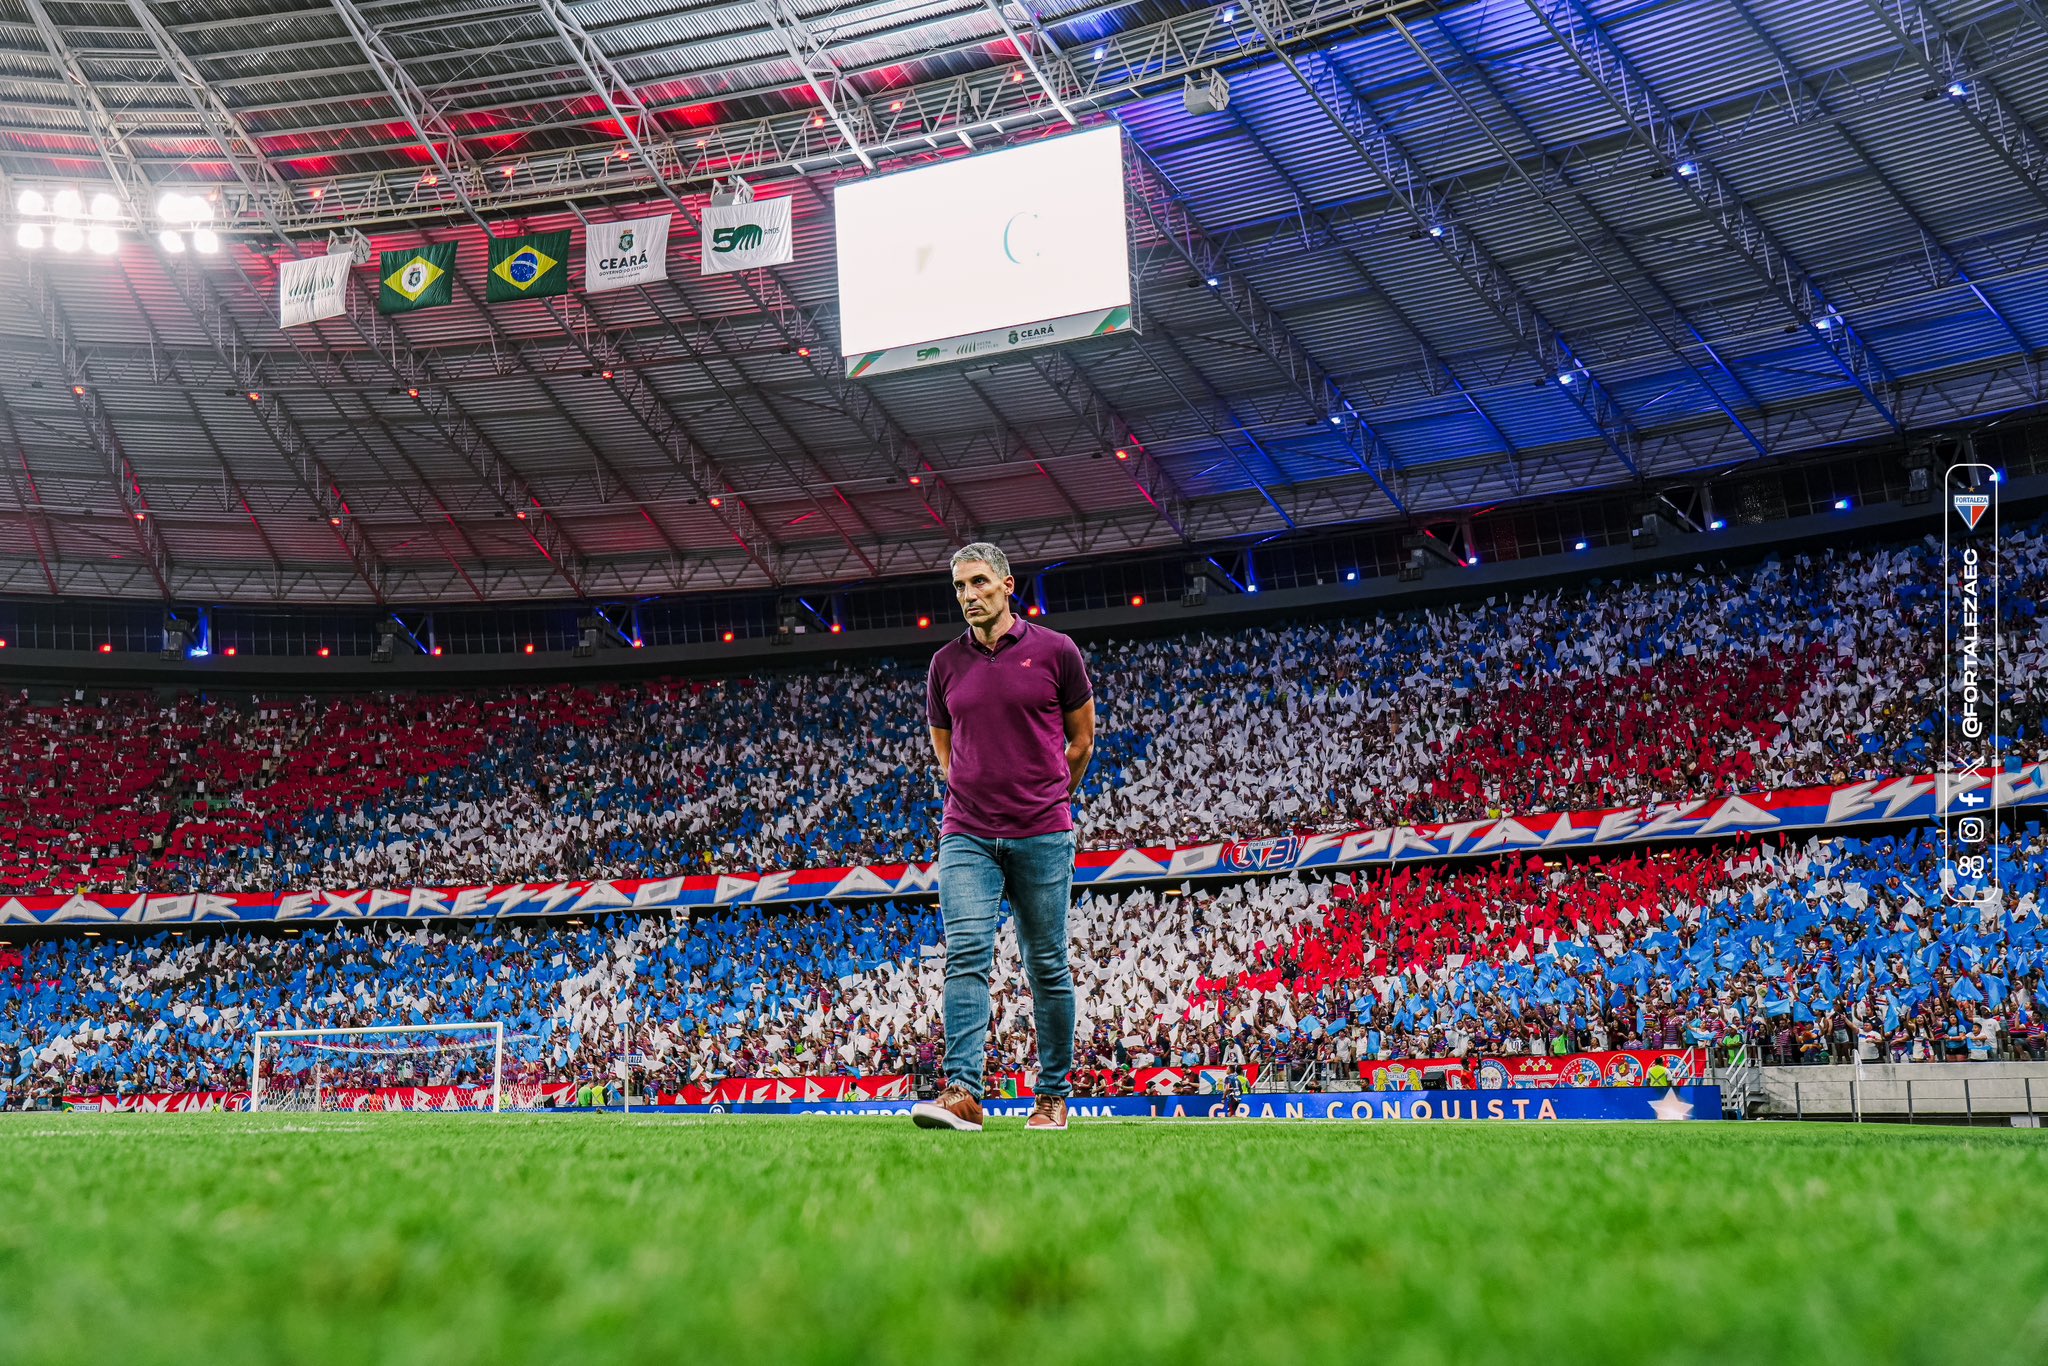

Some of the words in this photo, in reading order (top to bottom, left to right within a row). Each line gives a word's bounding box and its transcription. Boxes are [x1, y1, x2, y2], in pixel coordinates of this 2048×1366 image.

[599, 250, 648, 270] CEARÁ
[599, 269, 623, 277] GOVERNO
[631, 264, 649, 272] ESTADO
[1020, 324, 1055, 338] CEARÁ
[1249, 839, 1277, 849] FORTALEZA
[274, 876, 684, 921] EXPRESSÃO
[714, 870, 796, 903] DE
[1095, 843, 1224, 882] AO
[1296, 794, 1781, 868] FORTALEZA
[1151, 1104, 1187, 1119] LA
[1208, 1101, 1303, 1119] GRAN
[1327, 1099, 1557, 1120] CONQUISTA
